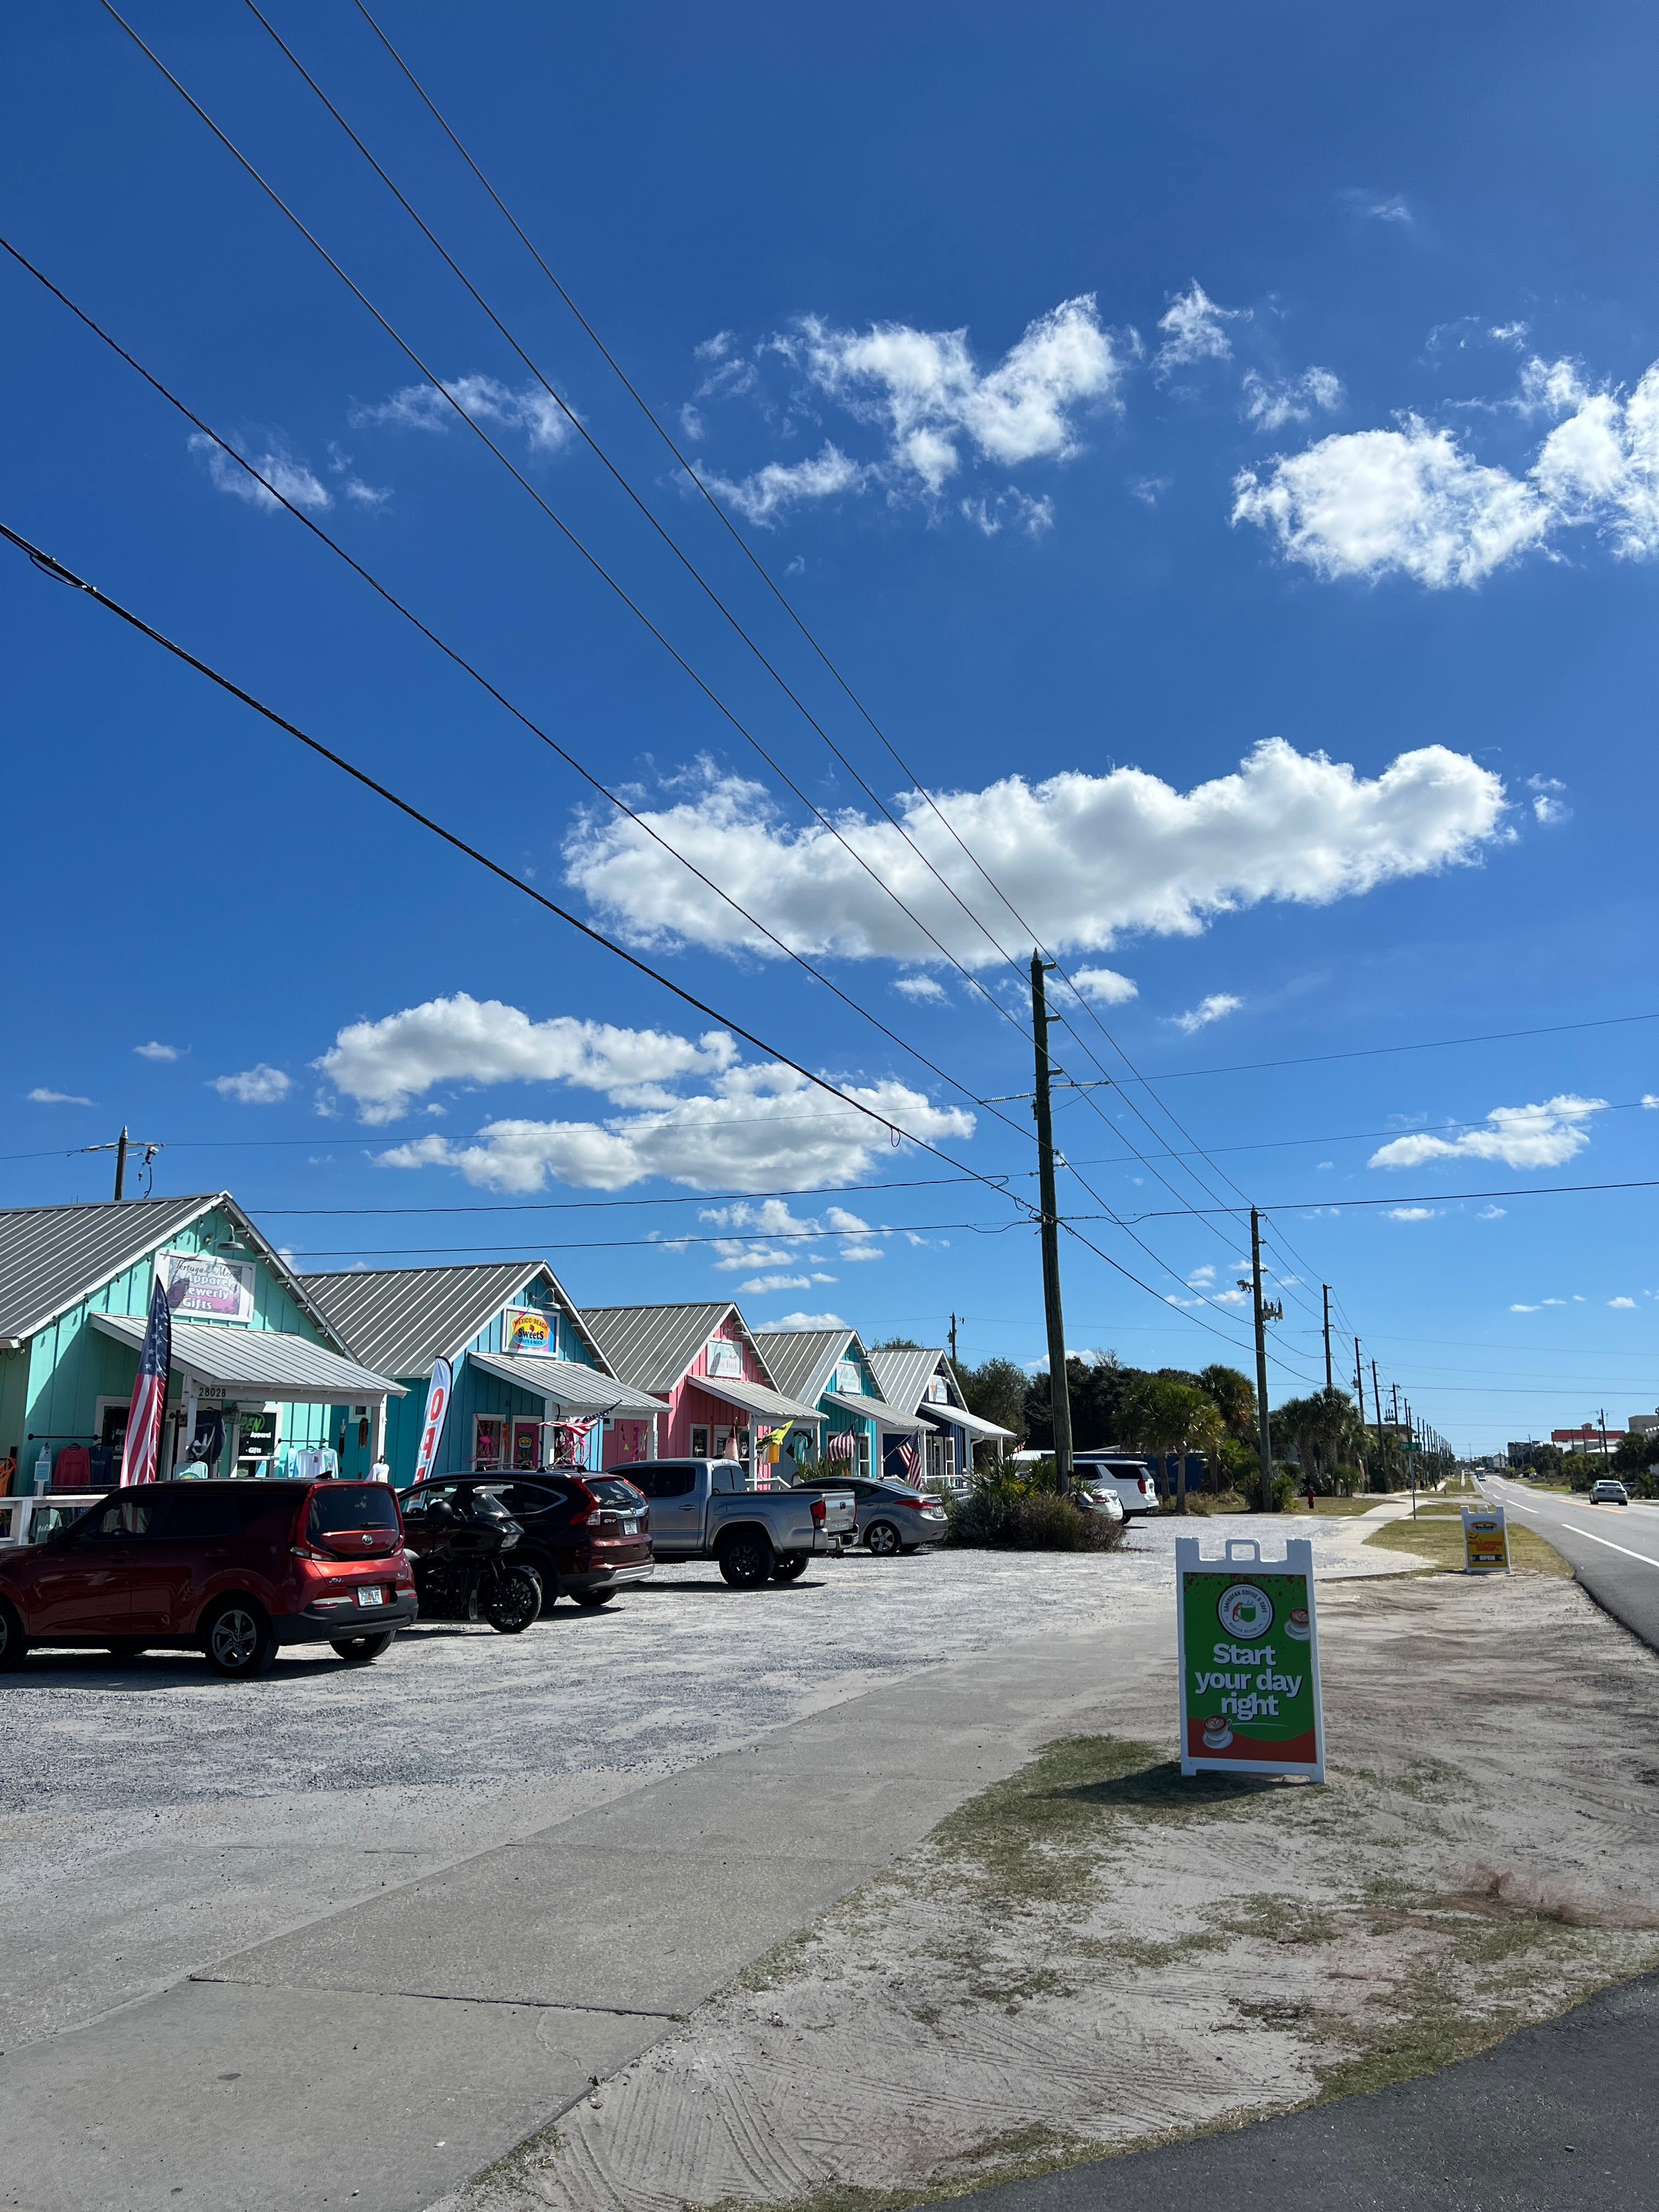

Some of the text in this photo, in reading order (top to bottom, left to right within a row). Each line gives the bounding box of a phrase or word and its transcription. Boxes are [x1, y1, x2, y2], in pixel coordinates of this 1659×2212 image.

[175, 1258, 204, 1276] Tortuga
[185, 1272, 232, 1287] Apparel
[184, 1284, 229, 1300] Jewerly
[182, 1297, 212, 1310] Gifts
[534, 1318, 548, 1330] BEACH
[1224, 1591, 1241, 1612] CARIBBEAN
[1242, 1590, 1259, 1599] COFFEE
[1213, 1643, 1277, 1666] Start
[1195, 1668, 1302, 1697] your day
[1221, 1691, 1279, 1720] right
